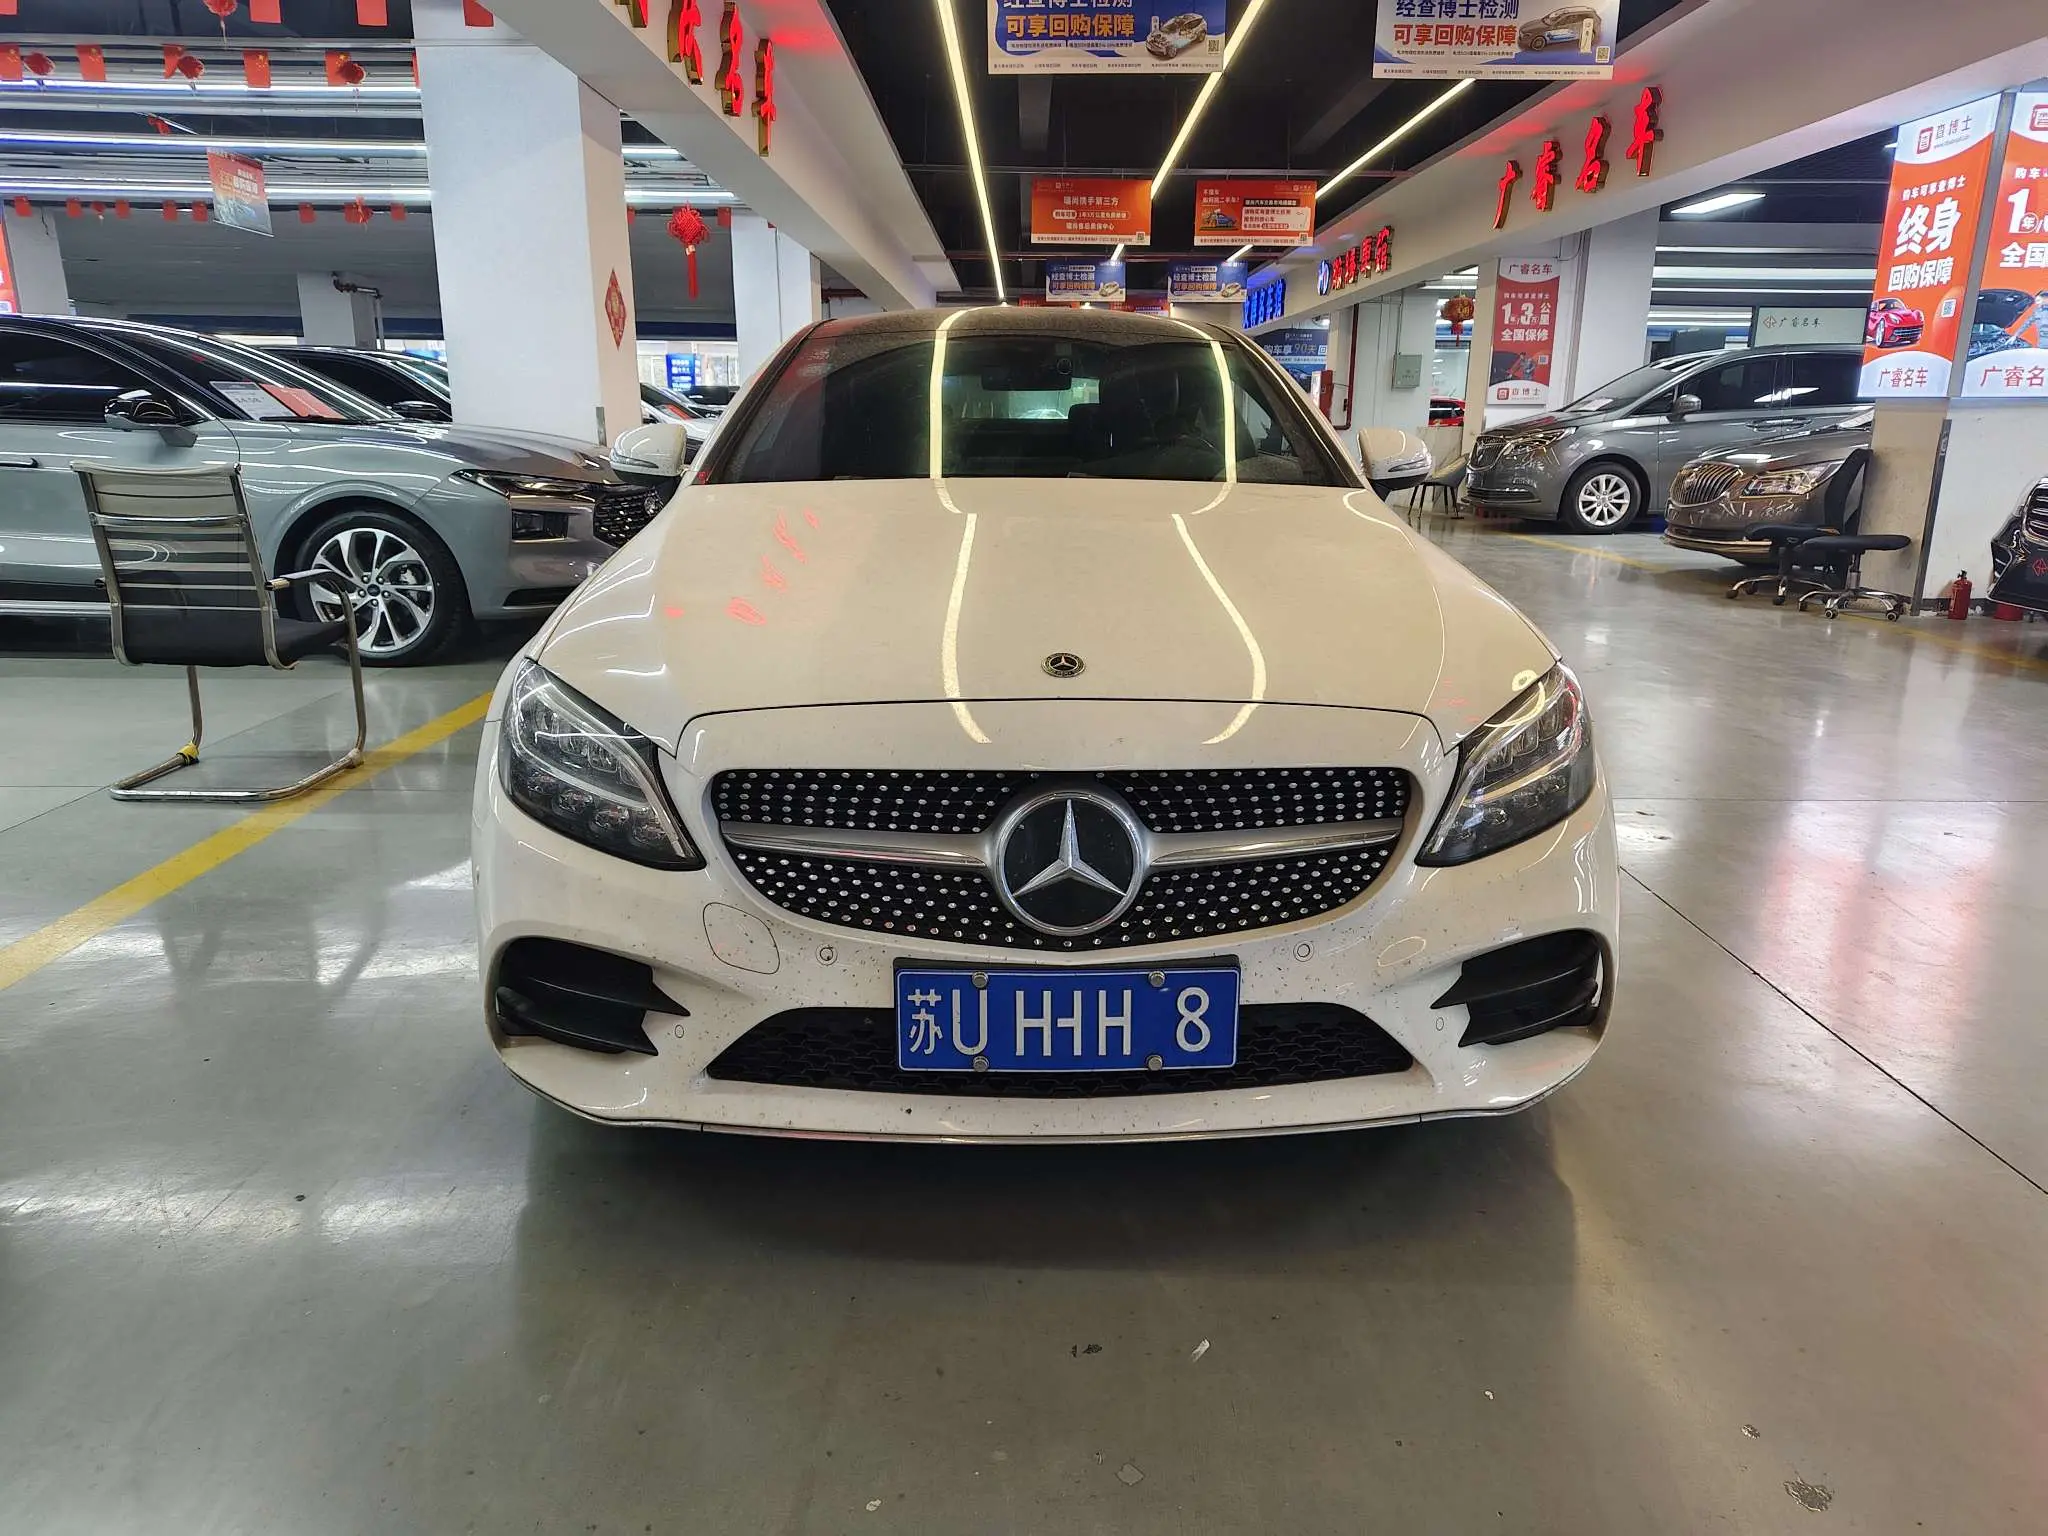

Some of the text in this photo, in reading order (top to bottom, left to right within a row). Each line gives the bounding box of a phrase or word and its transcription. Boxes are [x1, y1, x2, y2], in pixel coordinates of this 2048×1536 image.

[1396, 0, 1519, 19] 经查博士检测
[1006, 14, 1135, 37] 可享回购保障
[1394, 24, 1518, 46] 可享回购保障
[1936, 115, 1973, 141] 查博士
[2014, 167, 2048, 179] 购车
[2008, 188, 2048, 234] 1年/
[1894, 197, 1962, 257] 终身
[1508, 263, 1553, 276] 广睿名车
[1888, 256, 1953, 292] 回购保障
[1501, 328, 1549, 342] 全国保修
[1878, 366, 1928, 389] 广睿名车
[1980, 364, 2046, 388] 广睿名
